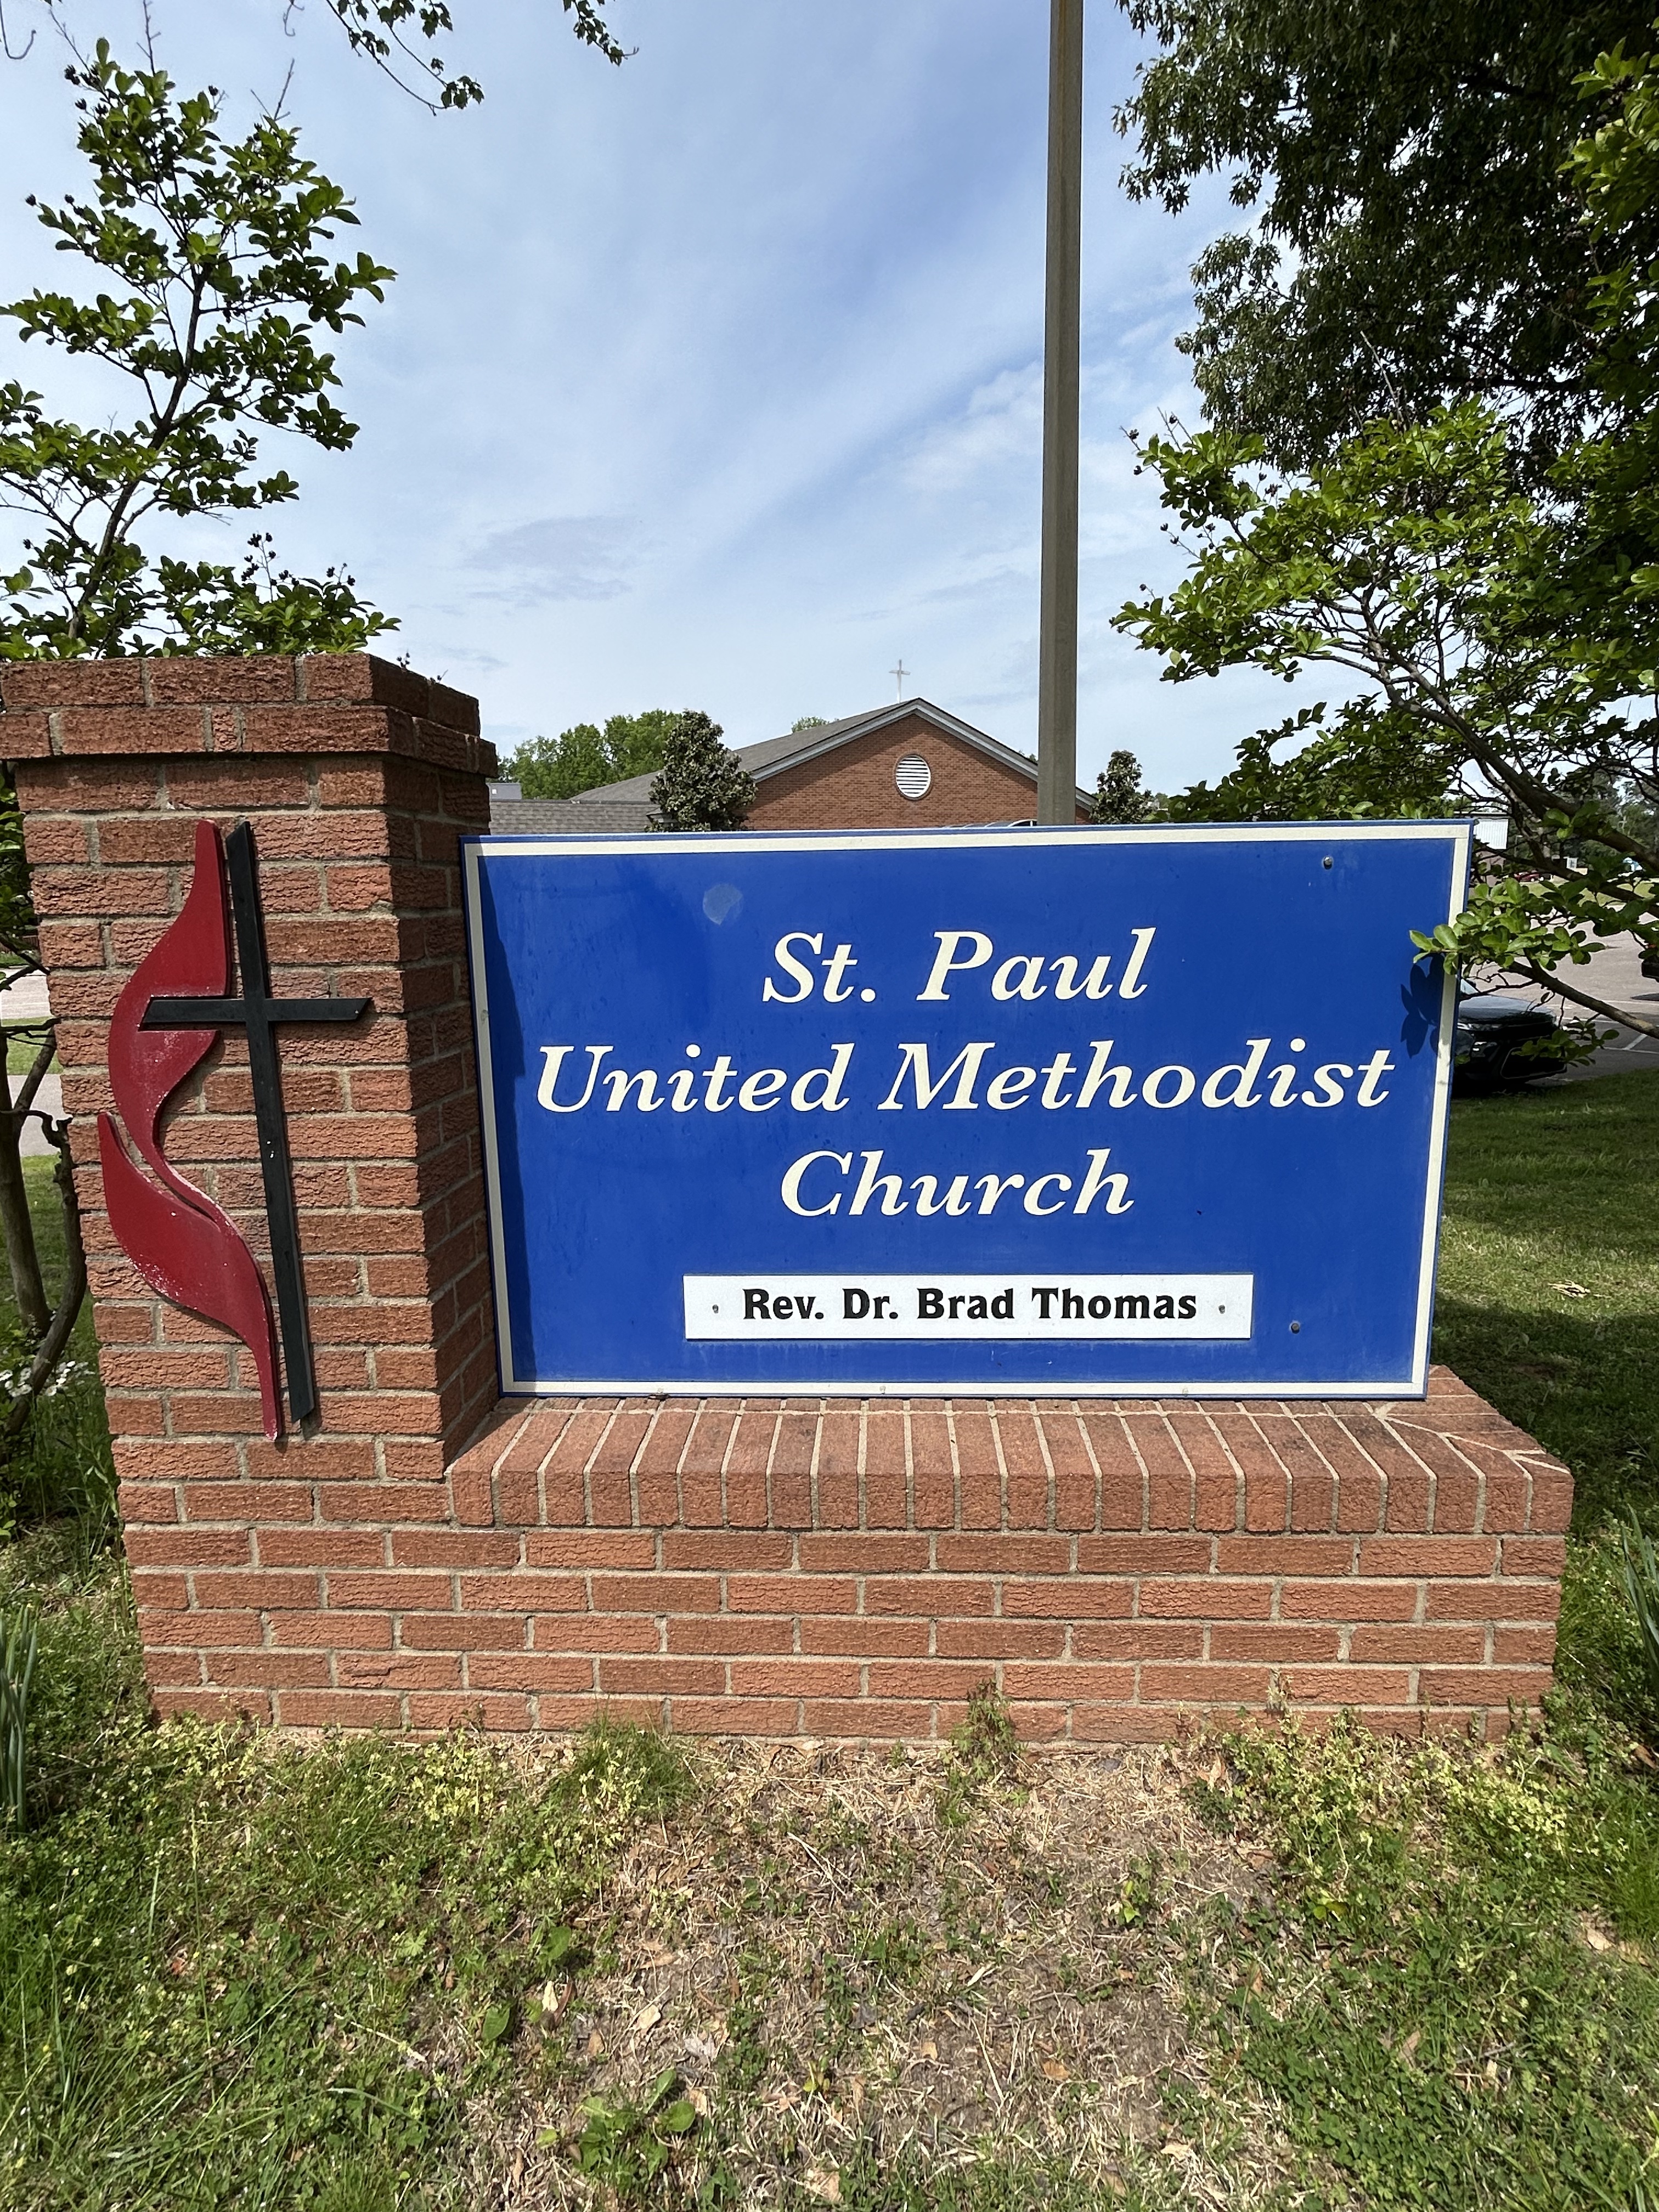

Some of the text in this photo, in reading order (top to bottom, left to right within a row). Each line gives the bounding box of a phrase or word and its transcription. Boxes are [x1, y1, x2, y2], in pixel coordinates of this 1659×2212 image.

[762, 927, 1156, 1003] St. Paul
[537, 1038, 1396, 1113] United Methodist
[781, 1148, 1135, 1217] Church
[743, 1287, 1196, 1320] Rev. Dr. Brad Thomas
